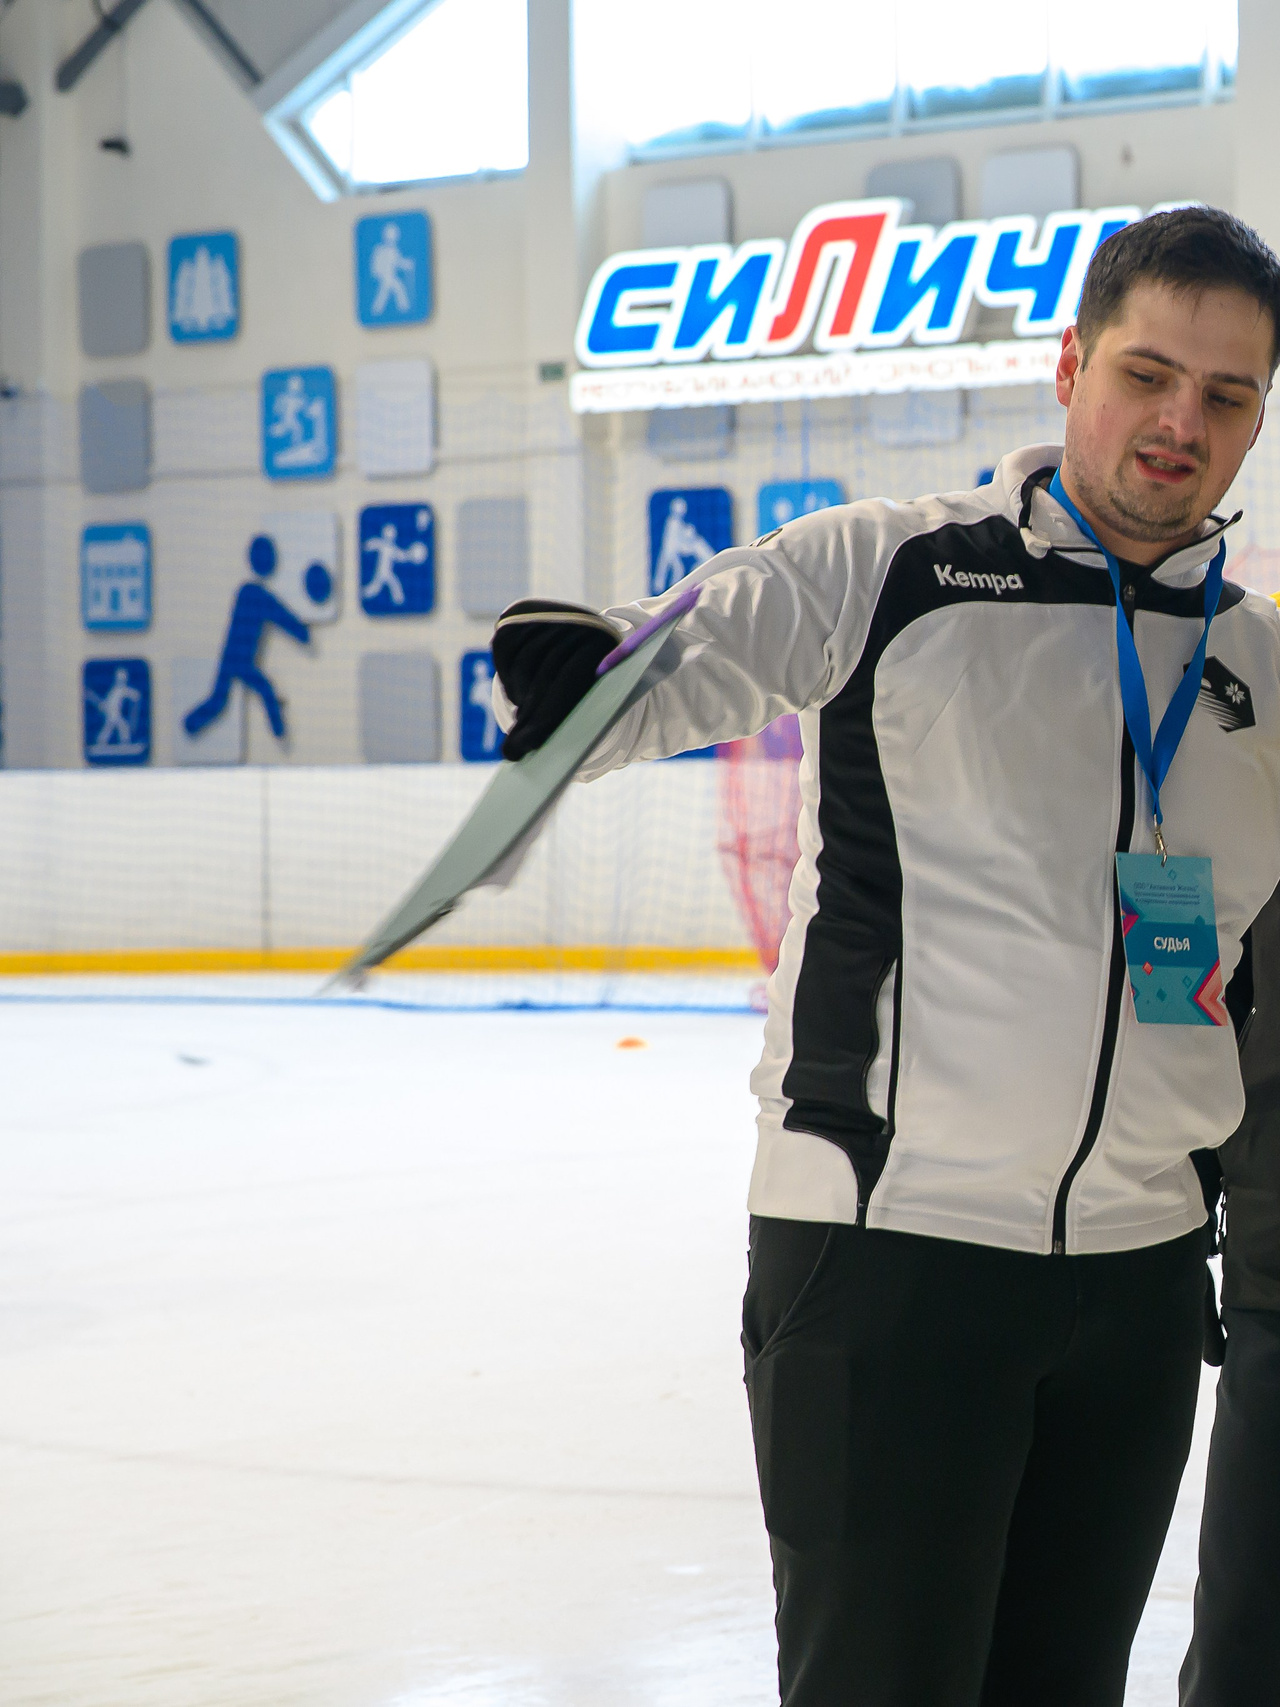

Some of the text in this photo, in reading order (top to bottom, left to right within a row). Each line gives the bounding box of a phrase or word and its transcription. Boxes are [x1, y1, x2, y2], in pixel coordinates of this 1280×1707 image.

[586, 211, 1131, 355] СИЛИЧ
[933, 563, 1024, 595] Kempa
[1153, 936, 1190, 953] СУДЬЯ
